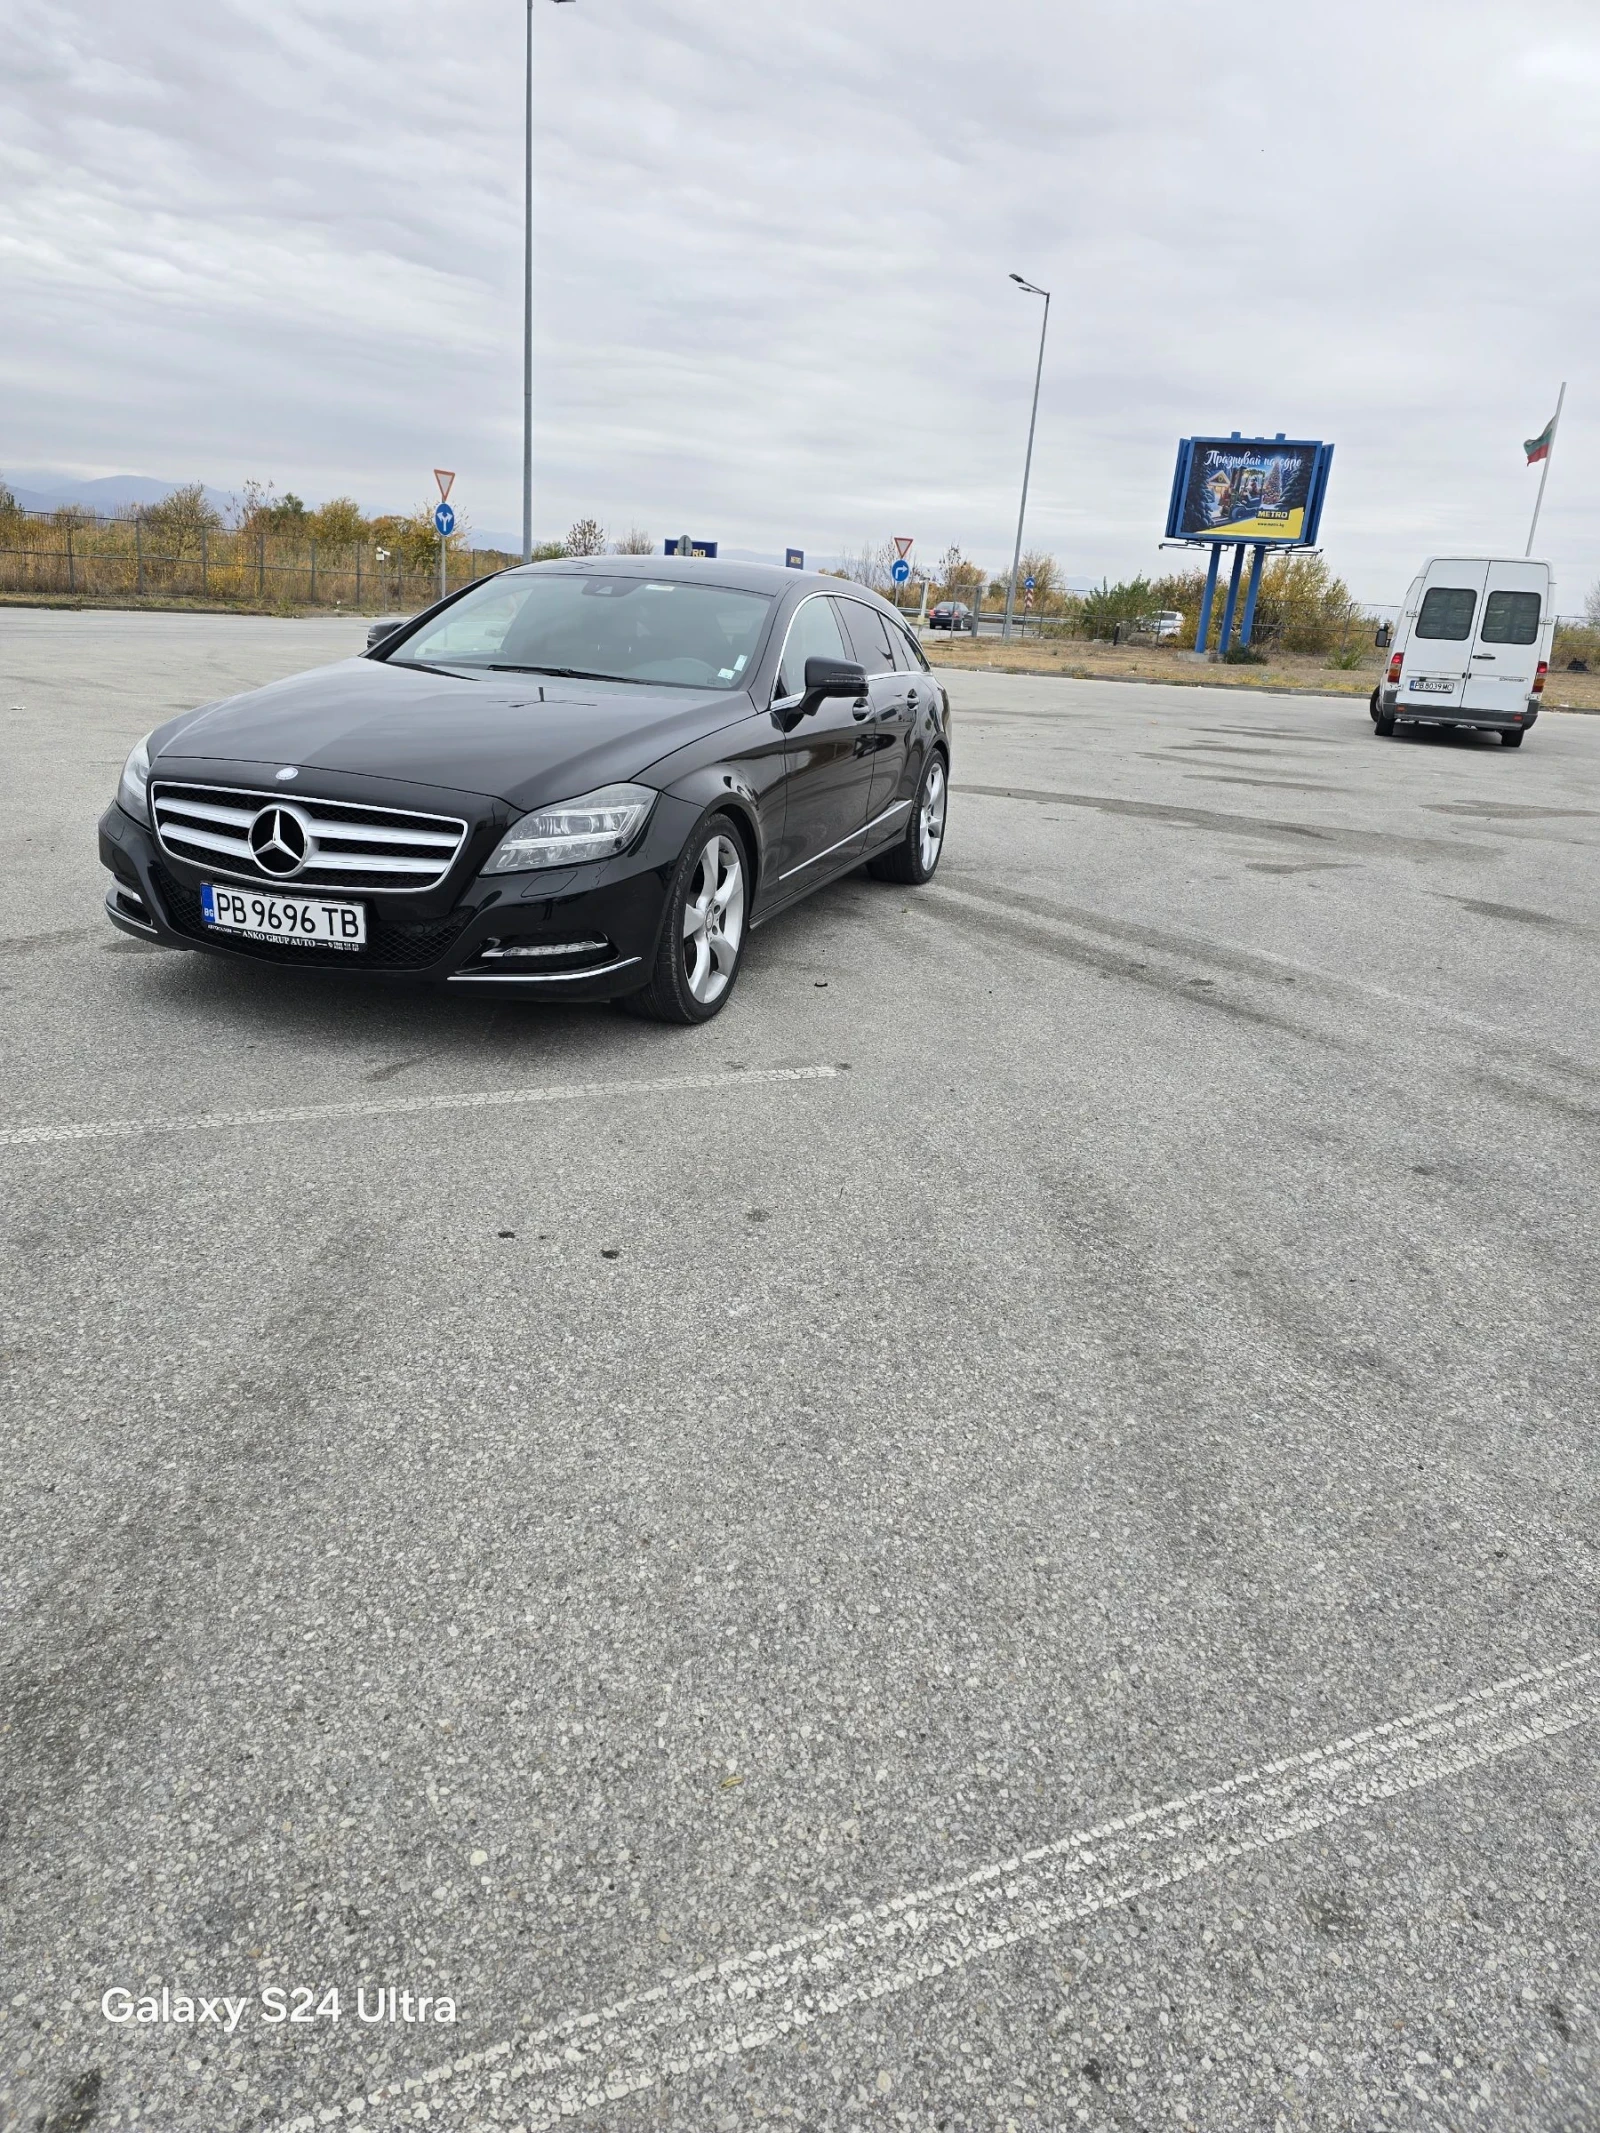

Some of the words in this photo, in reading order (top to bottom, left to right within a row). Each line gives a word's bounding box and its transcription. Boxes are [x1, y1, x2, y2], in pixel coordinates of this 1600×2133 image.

[1257, 510, 1288, 518] METRO
[204, 907, 214, 918] BG
[216, 892, 247, 924] PB
[251, 899, 316, 934] 9696
[321, 906, 359, 938] TB
[242, 930, 265, 941] ANKO
[266, 934, 290, 945] GRUP
[290, 938, 316, 948] AUTO
